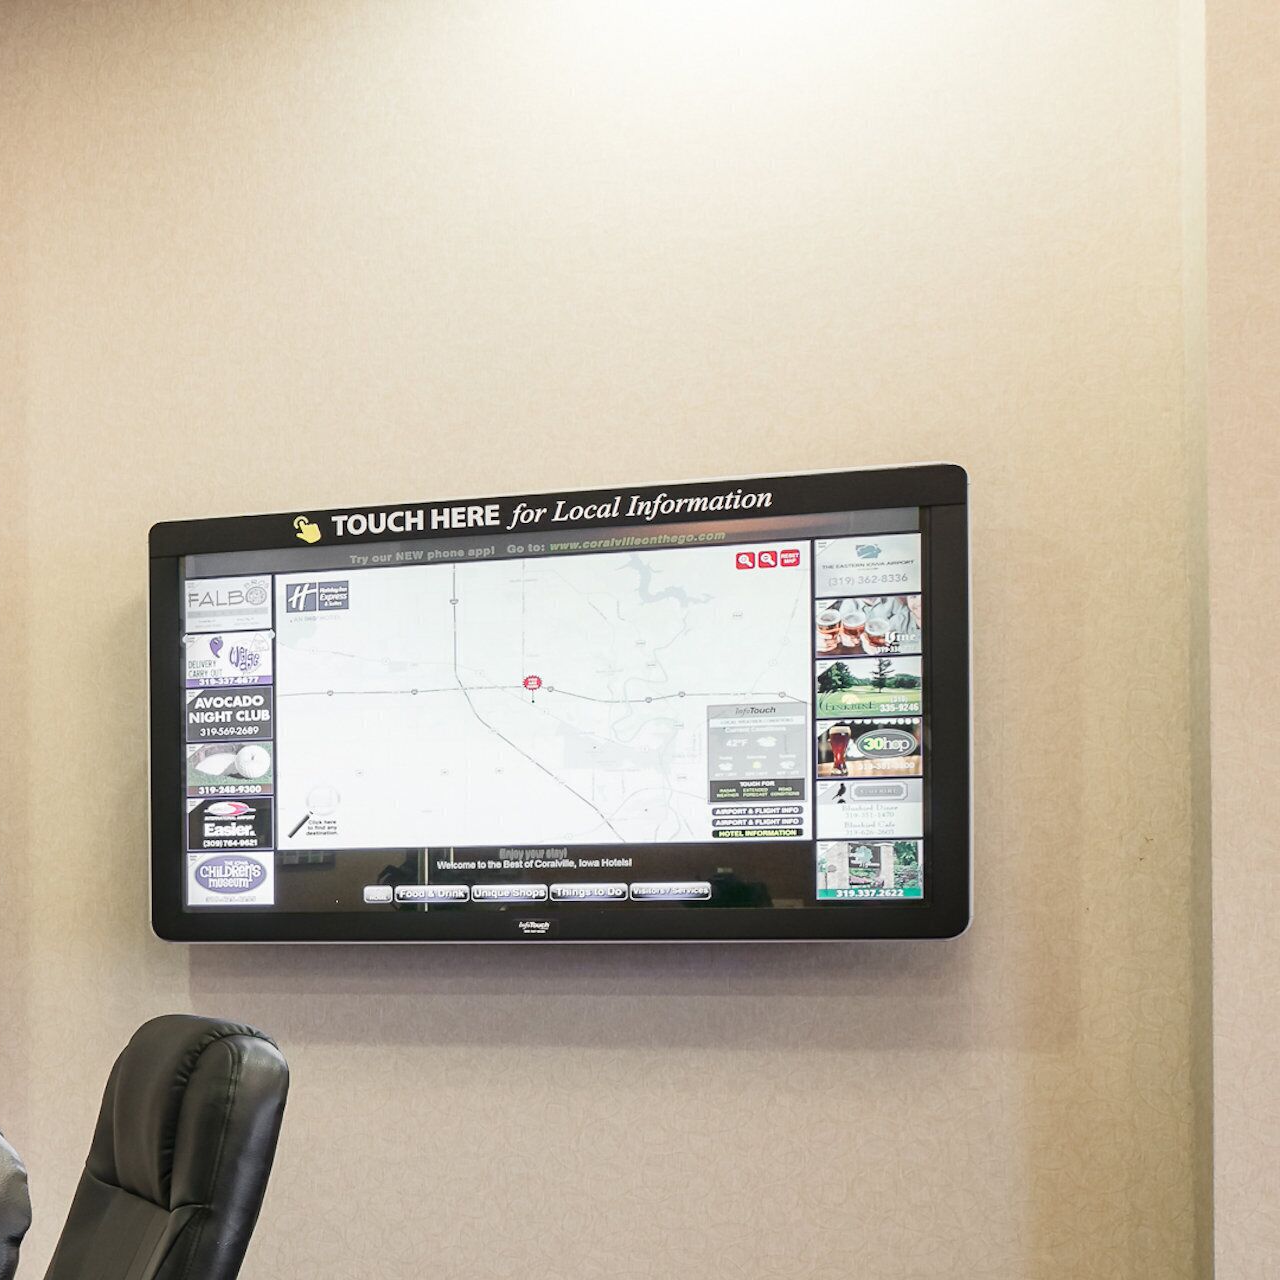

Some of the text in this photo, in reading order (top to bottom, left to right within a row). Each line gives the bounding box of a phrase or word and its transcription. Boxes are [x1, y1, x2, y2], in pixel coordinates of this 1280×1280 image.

[331, 489, 772, 537] TOUCH HERE for Local Information
[349, 555, 369, 565] Try
[372, 554, 392, 563] our
[396, 550, 424, 562] NEW
[427, 548, 465, 561] phone
[506, 544, 524, 554] Go
[527, 543, 546, 553] to:
[550, 530, 726, 551] www.coralvilleonthego.com
[828, 574, 909, 587] (319) 362-8336
[188, 660, 216, 669] DELIVERY
[194, 695, 264, 709] AVOCADO
[189, 709, 271, 724] NIGHT CLUB
[864, 737, 910, 752] 30hop
[198, 785, 262, 795] 319-248-9300
[745, 829, 797, 837] INFORMATION
[499, 848, 524, 860] Enjoy
[436, 858, 633, 869] Welcome to the Best of Coralville, Iowa Hotels!
[399, 889, 464, 898] Food & Drink
[474, 888, 546, 899] Unique Shops
[556, 887, 623, 898] Things to Do
[836, 889, 905, 898] 319.337.2622
